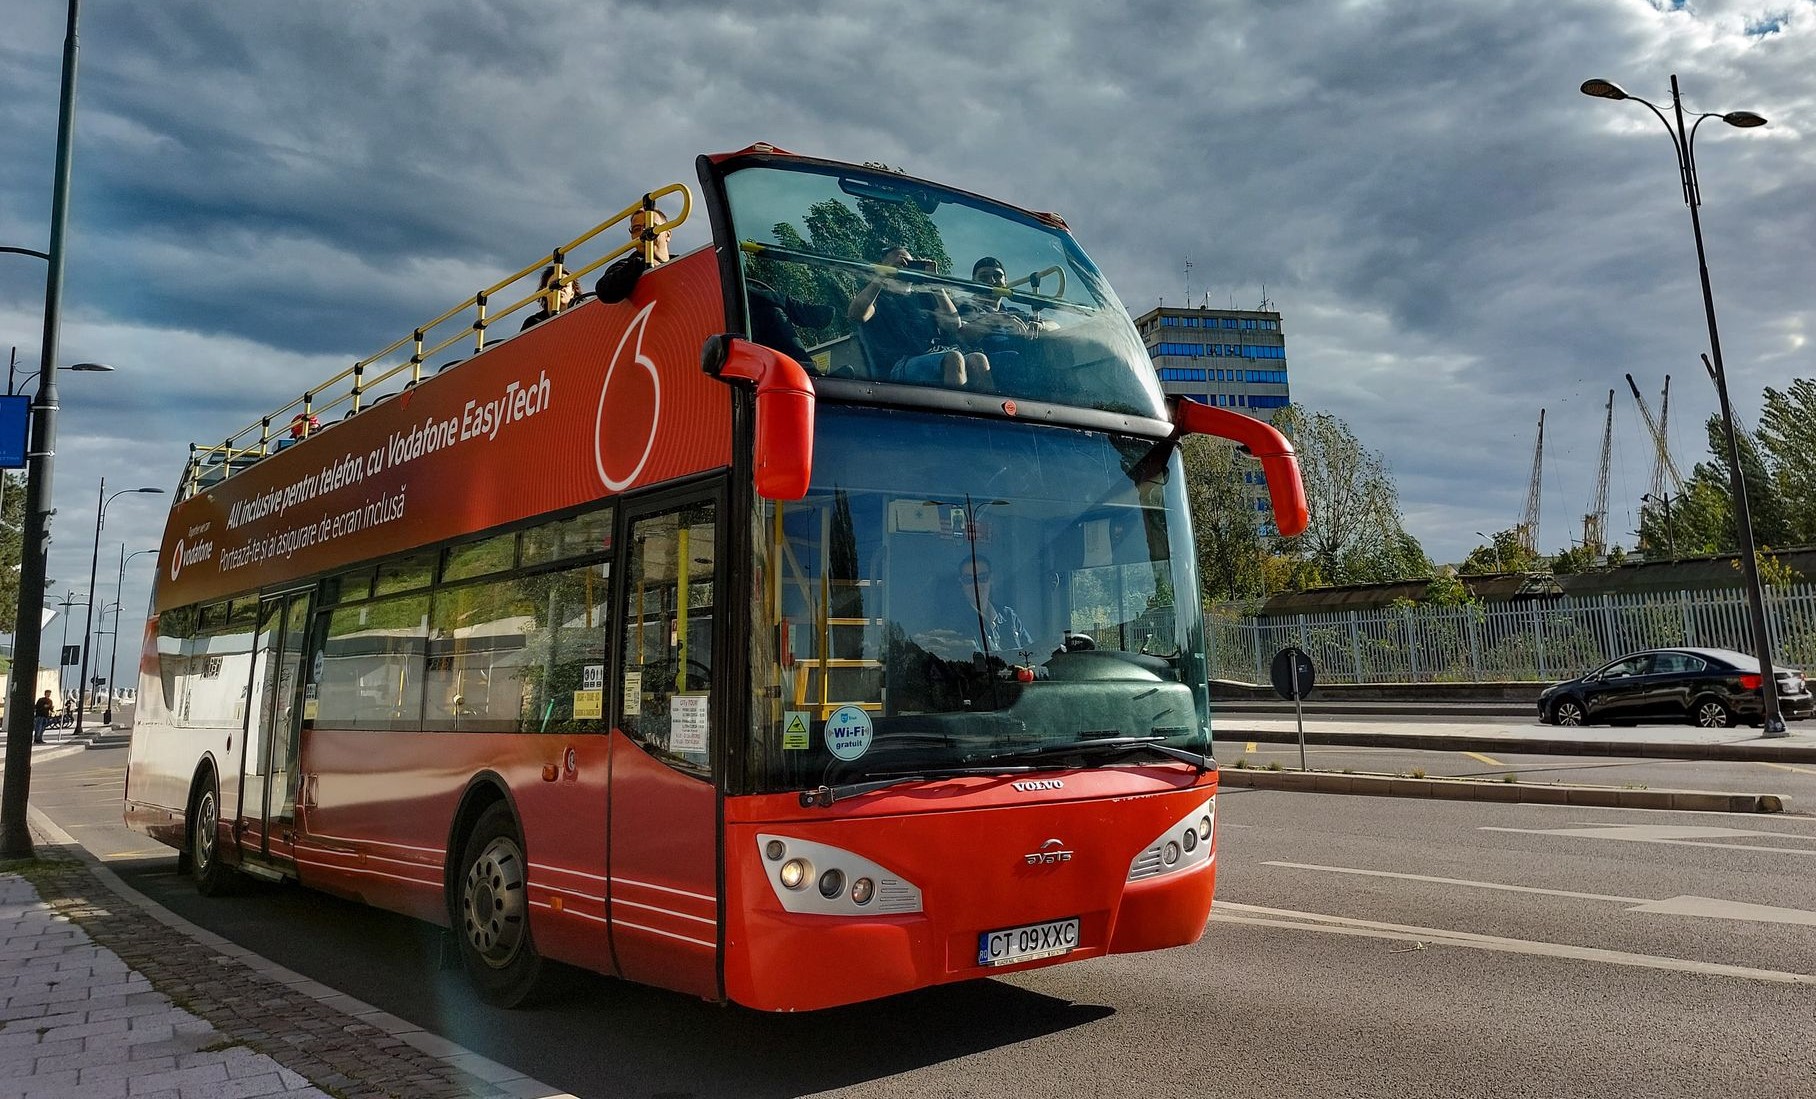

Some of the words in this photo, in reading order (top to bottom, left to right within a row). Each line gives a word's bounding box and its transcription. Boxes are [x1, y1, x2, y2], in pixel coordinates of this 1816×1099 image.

[226, 500, 242, 531] All
[240, 486, 282, 526] inclusive
[280, 474, 320, 517] pentru
[319, 453, 363, 495] telefon,
[367, 447, 385, 476] cu
[387, 417, 458, 469] Vodafone
[460, 370, 550, 441] EasyTech
[219, 538, 260, 573] Portează-te
[268, 530, 278, 558] ai
[277, 526, 317, 559] asigurare
[318, 513, 331, 543] de
[332, 508, 362, 539] ecran
[363, 484, 407, 530] inclusă
[183, 539, 213, 567] vodafone
[834, 726, 865, 738] Wi-Fi
[836, 740, 863, 750] gratuit
[1012, 779, 1064, 792] VOLVO
[990, 932, 1013, 957] CT
[1019, 922, 1075, 952] 09XXC
[980, 950, 988, 959] RO
